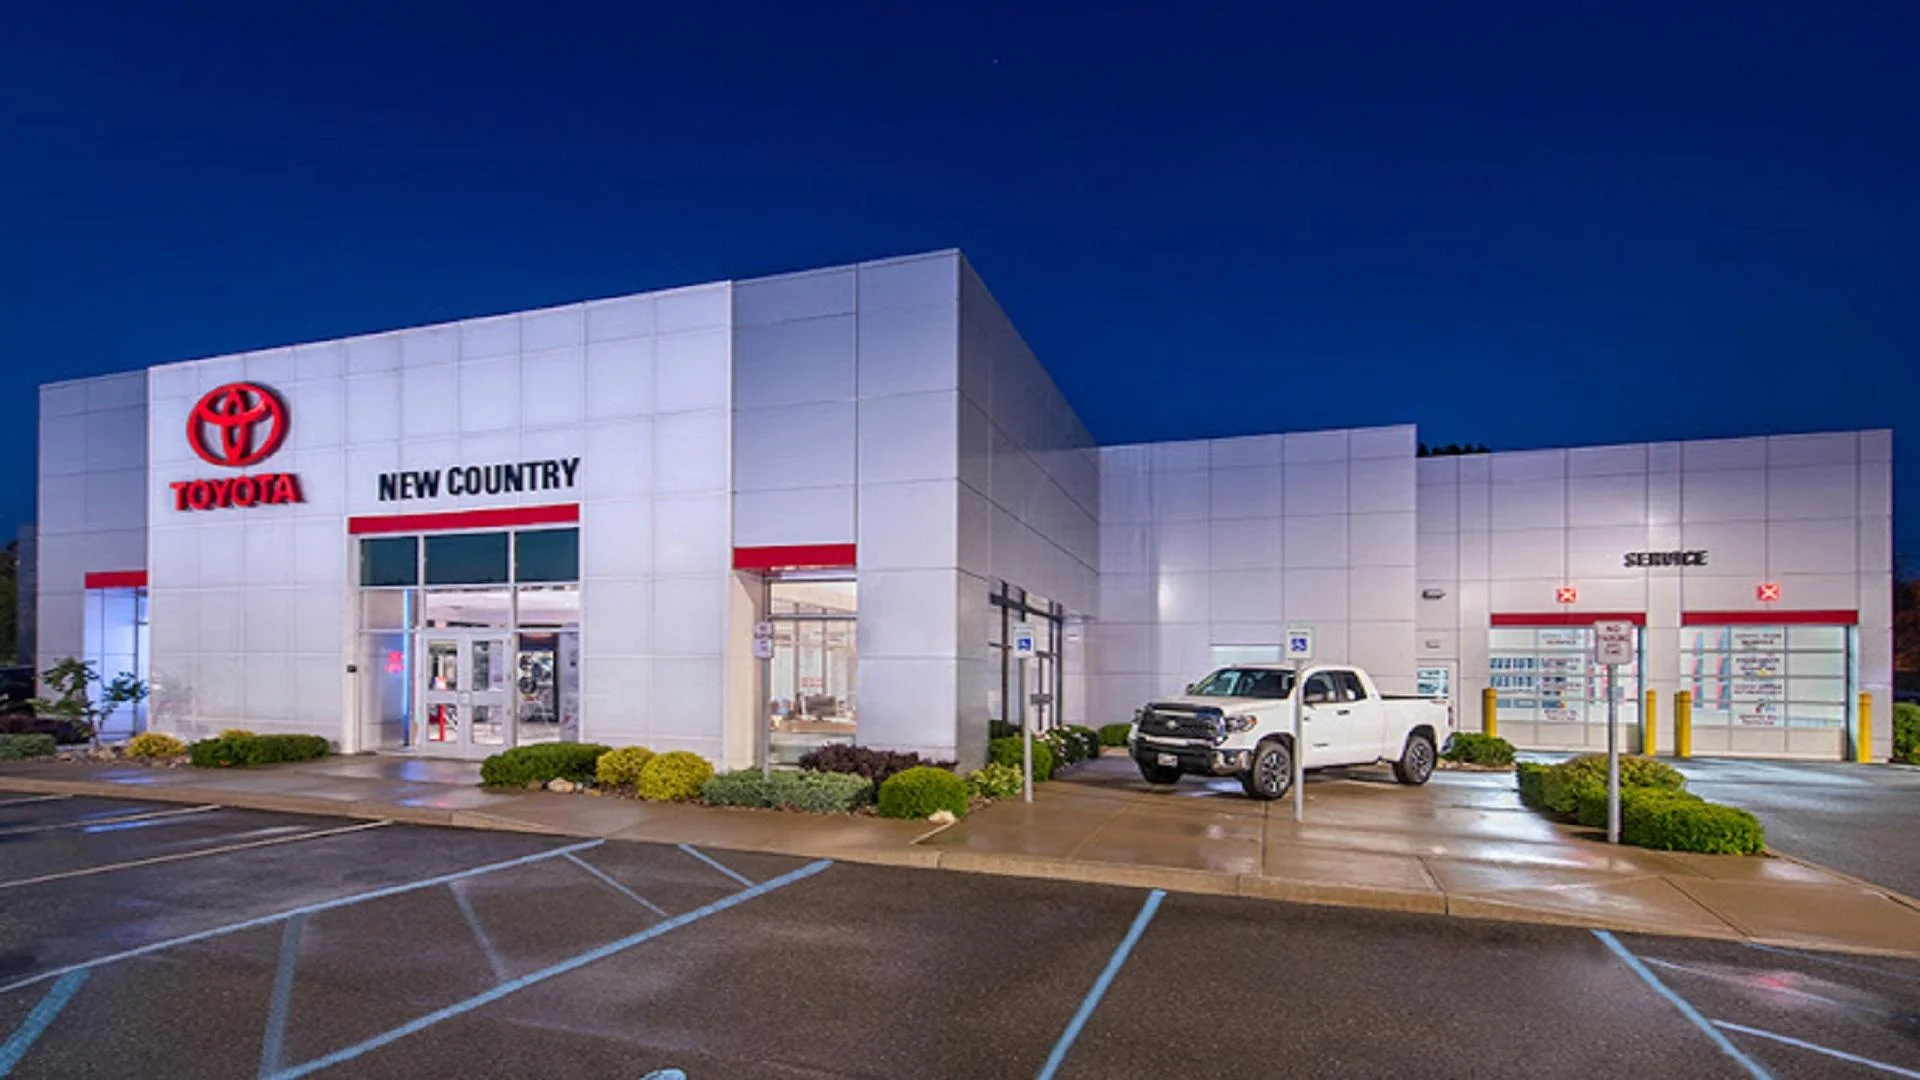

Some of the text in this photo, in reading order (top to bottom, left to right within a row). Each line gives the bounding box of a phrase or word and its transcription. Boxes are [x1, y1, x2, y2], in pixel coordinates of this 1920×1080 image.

[169, 472, 303, 511] TOYOTA
[378, 457, 580, 501] NEW COUNTRY
[1623, 550, 1708, 567] SERVICE
